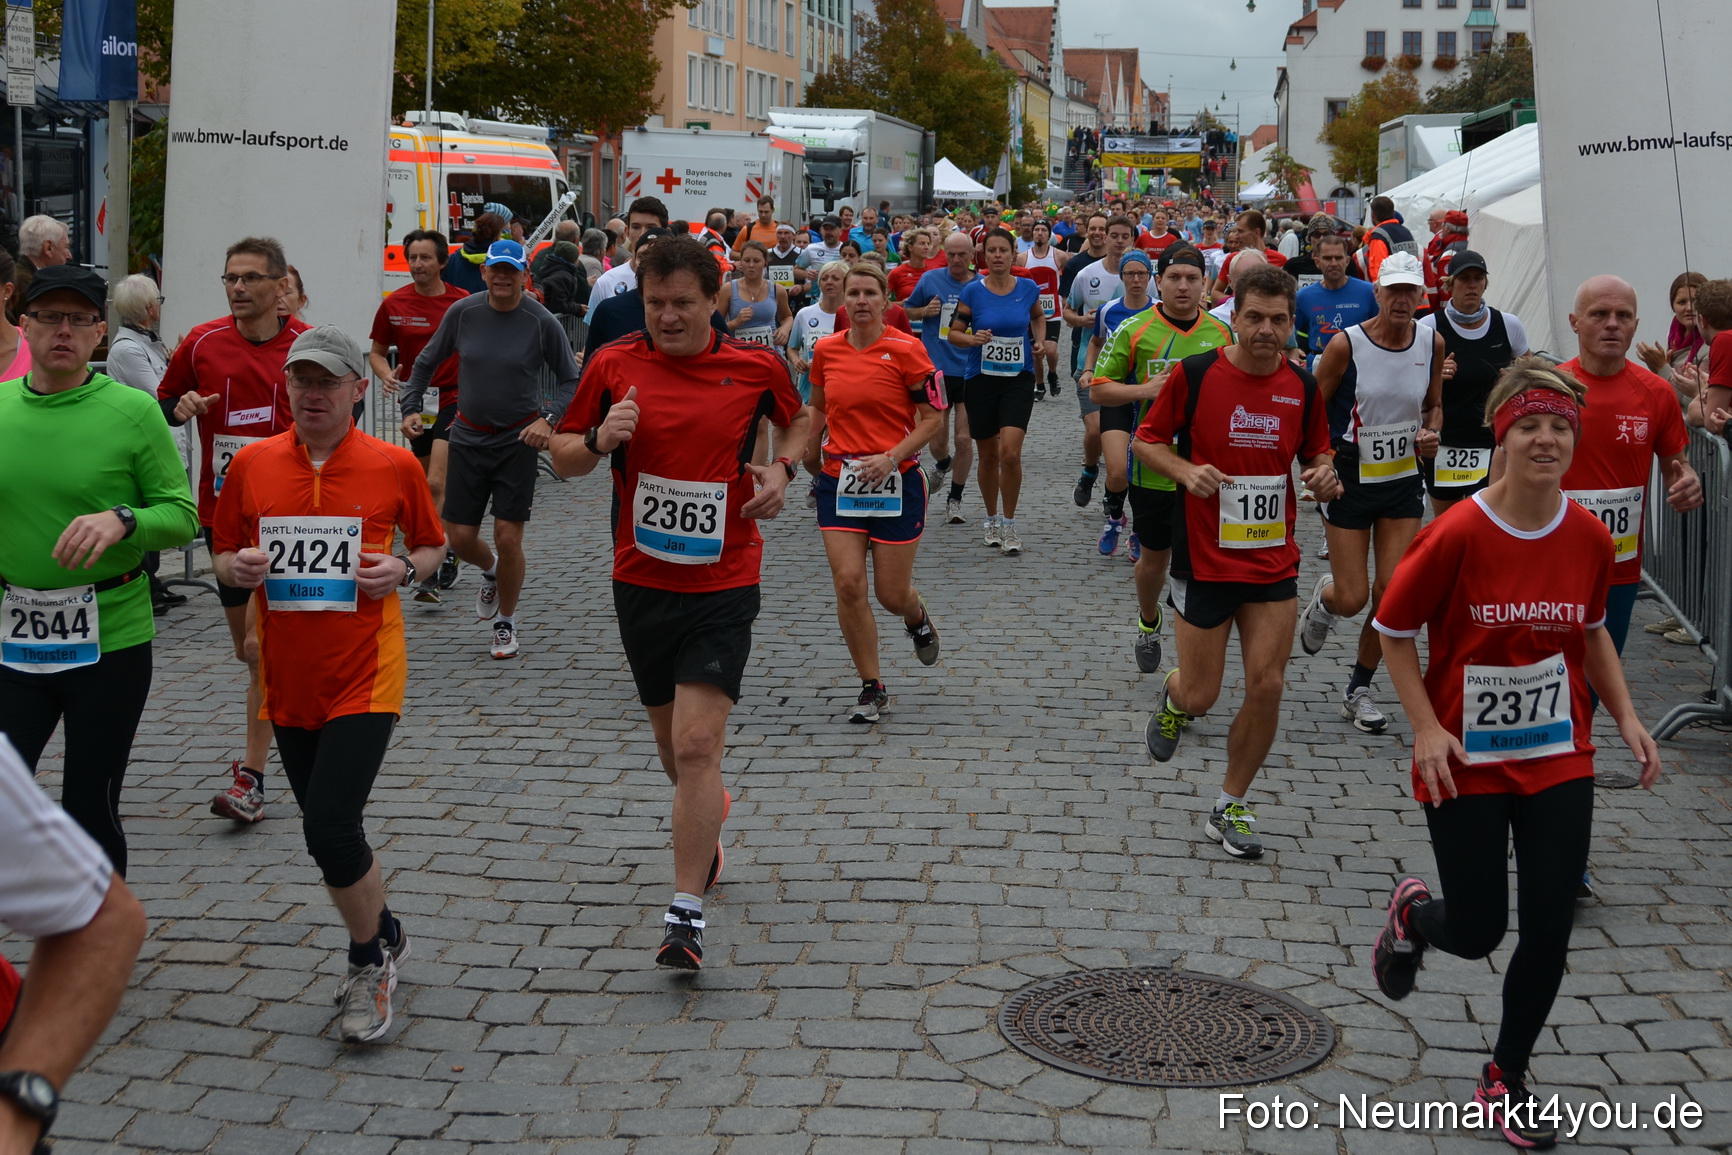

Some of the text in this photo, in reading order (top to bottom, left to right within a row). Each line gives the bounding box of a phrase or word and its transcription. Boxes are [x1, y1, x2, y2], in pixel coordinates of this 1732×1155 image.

[171, 128, 348, 151] www.bmw-laufsport.de
[1133, 155, 1168, 165] START
[685, 168, 733, 177] Bayerisches
[685, 178, 708, 186] Rotes
[684, 188, 707, 196] Kreuz
[936, 189, 969, 197] Laufsport
[773, 271, 789, 281] 323
[986, 345, 1021, 362] 2359
[240, 412, 260, 421] DEHN
[1382, 427, 1410, 437] Neumarkt
[214, 440, 239, 449] PARTL
[1372, 436, 1408, 461] 519
[1446, 449, 1480, 468] 325
[638, 480, 712, 500] PARTL Neumarkt
[1221, 483, 1248, 491] PARTL
[853, 500, 885, 509] Annette
[1237, 493, 1279, 521] 180
[1596, 495, 1632, 505] Neumarkt
[641, 494, 718, 535] 2363
[261, 525, 343, 535] PARTL Neumarkt
[1246, 527, 1270, 539] Peter
[664, 538, 686, 552] Jan
[268, 539, 352, 575] 2424
[289, 583, 325, 597] Klaus
[5, 593, 79, 607] PARTL Neumarkt
[1468, 601, 1575, 623] NEUMARKT
[10, 607, 91, 641] 2644
[20, 647, 78, 661] Thorsten
[1467, 669, 1554, 686] PARTL Neumarkt
[1476, 681, 1561, 726] 2377
[1490, 731, 1550, 748] Karoline
